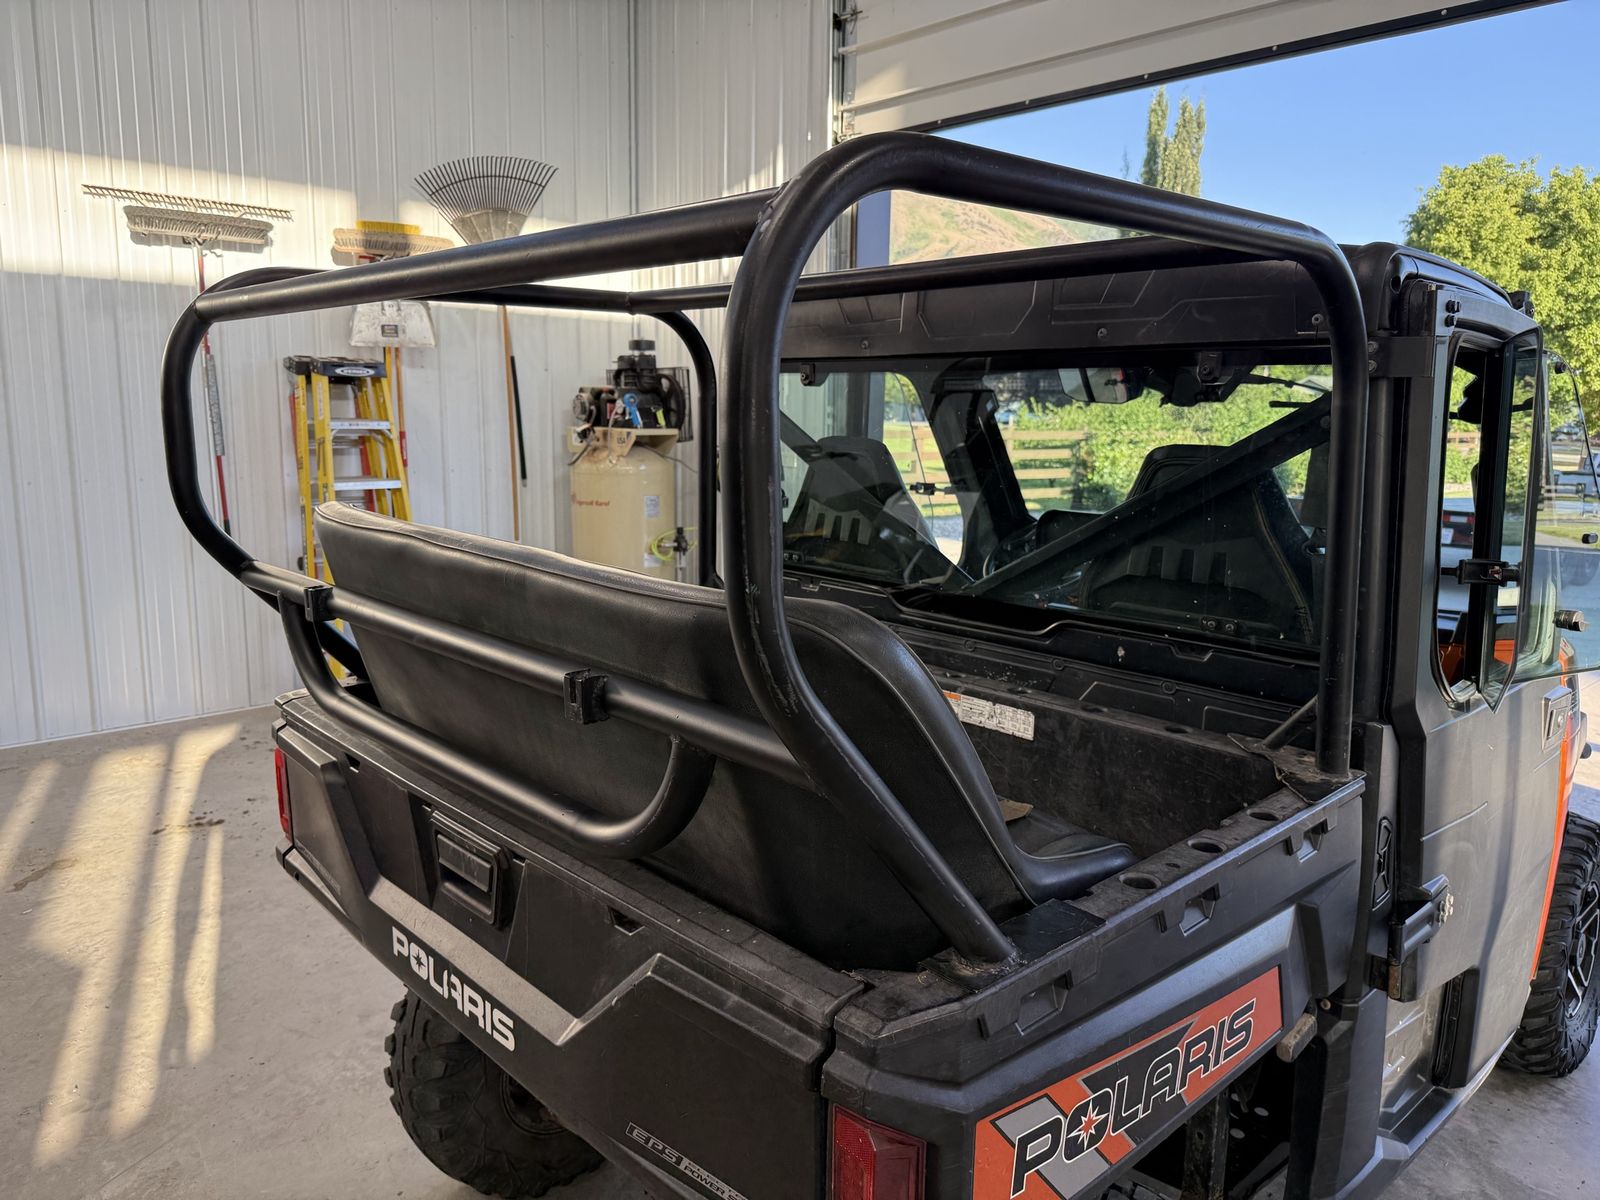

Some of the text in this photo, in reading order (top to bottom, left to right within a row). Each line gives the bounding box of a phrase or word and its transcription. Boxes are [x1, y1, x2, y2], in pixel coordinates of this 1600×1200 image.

[392, 926, 516, 1052] POLARIS
[1010, 998, 1256, 1199] POLARIS
[632, 1128, 679, 1163] EPS
[683, 1165, 726, 1197] POWER
